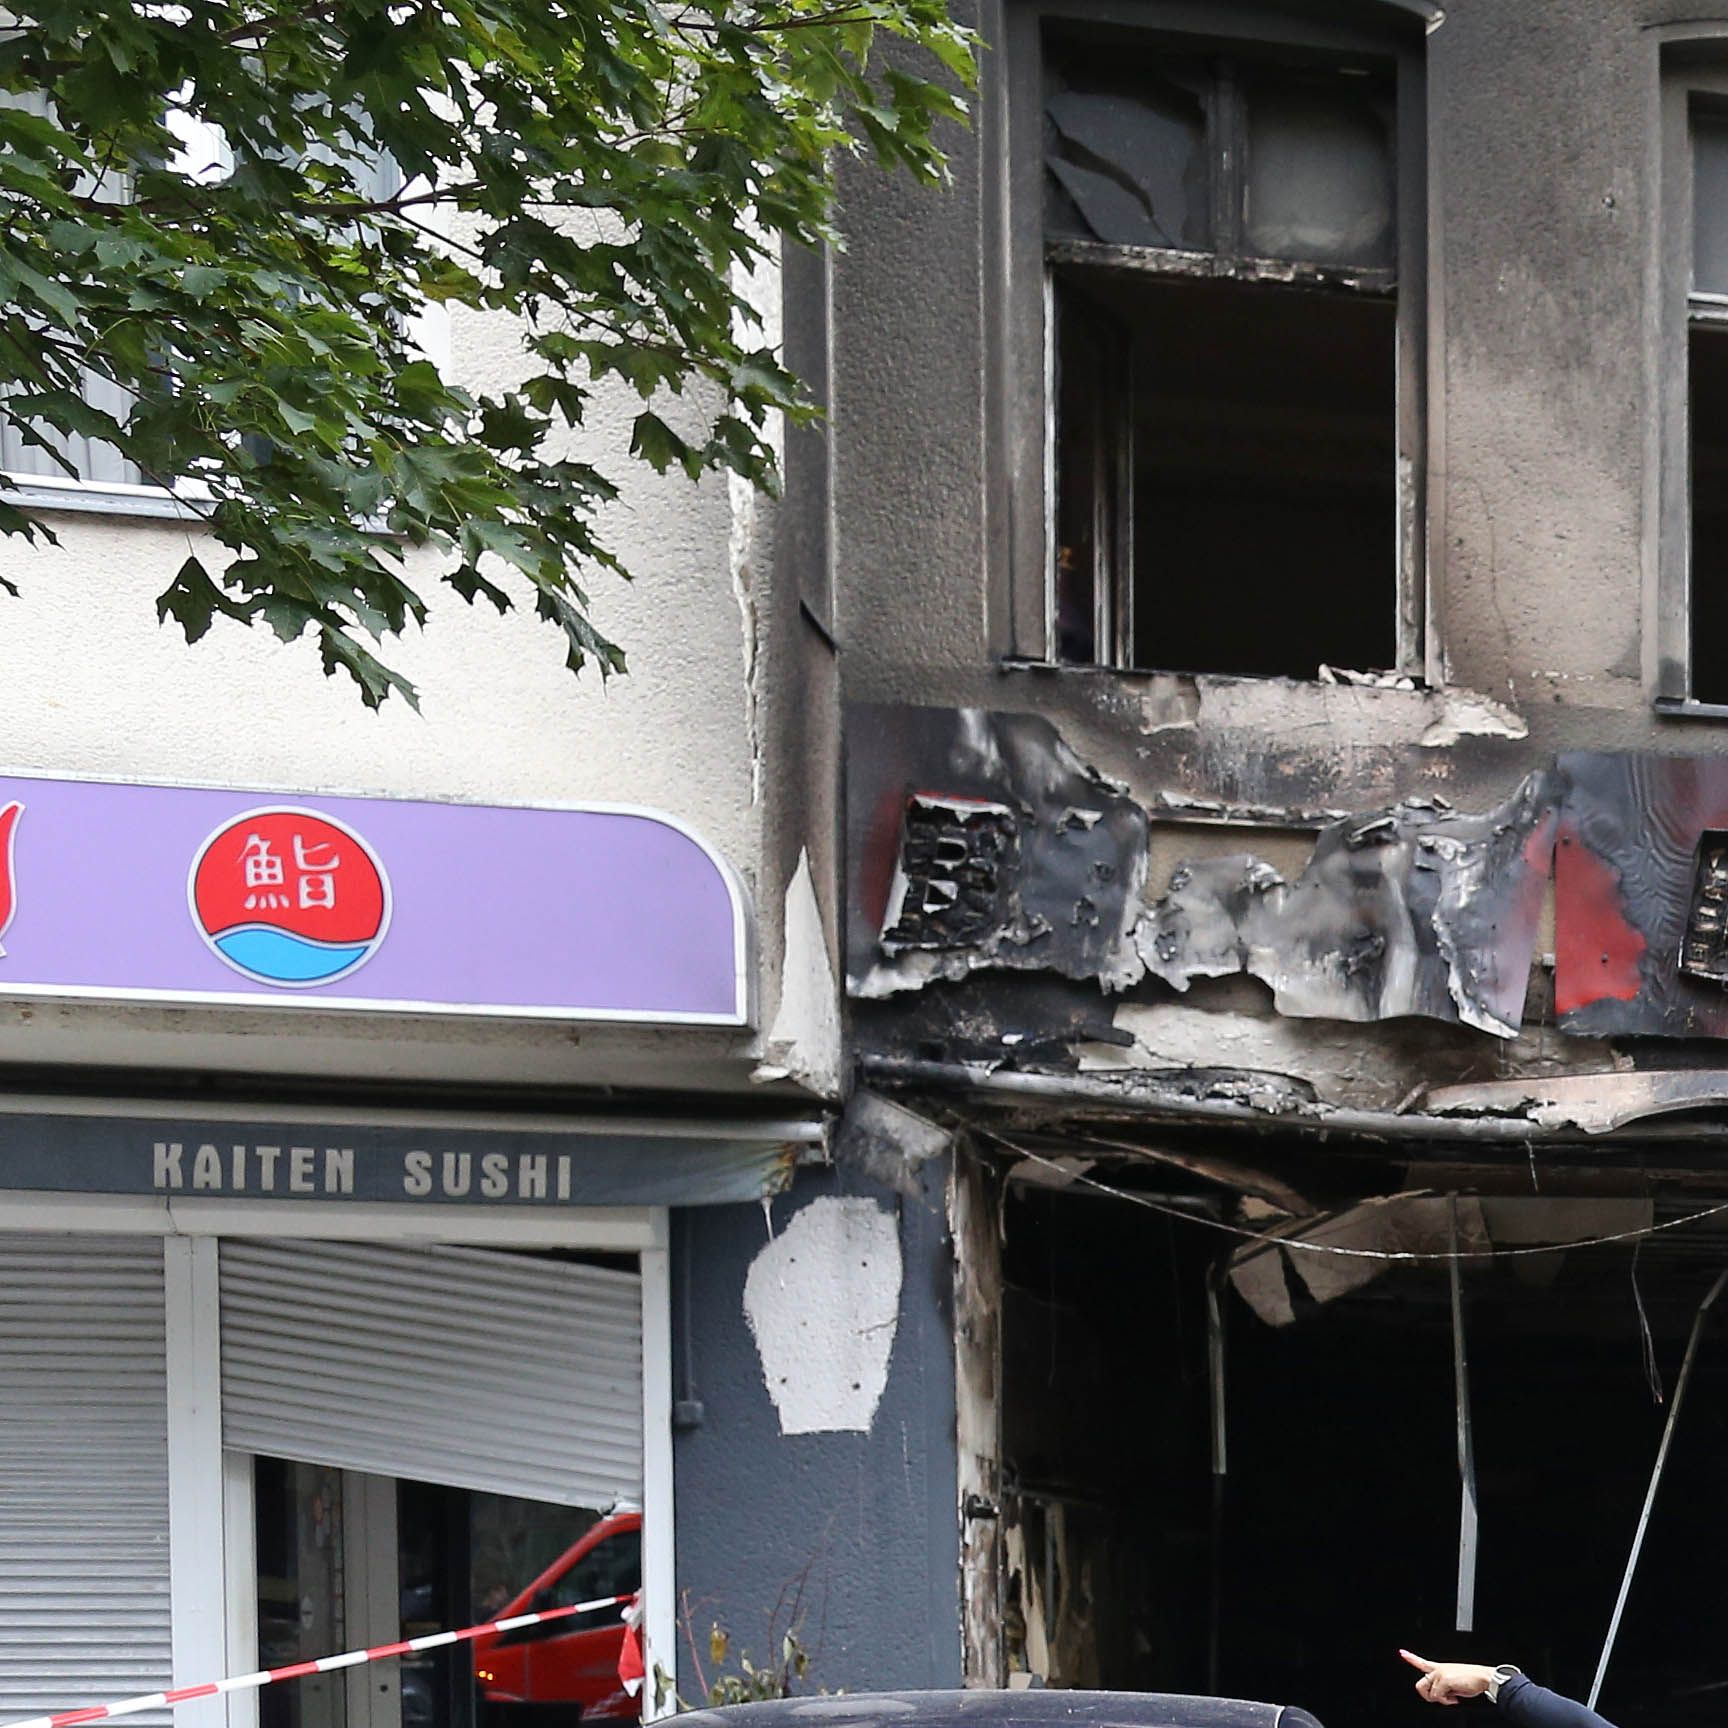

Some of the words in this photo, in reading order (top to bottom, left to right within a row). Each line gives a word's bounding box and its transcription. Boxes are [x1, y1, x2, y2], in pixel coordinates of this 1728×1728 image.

[237, 833, 340, 910] 鮨
[153, 1142, 355, 1193] KAITEN
[404, 1151, 571, 1200] SUSHI
